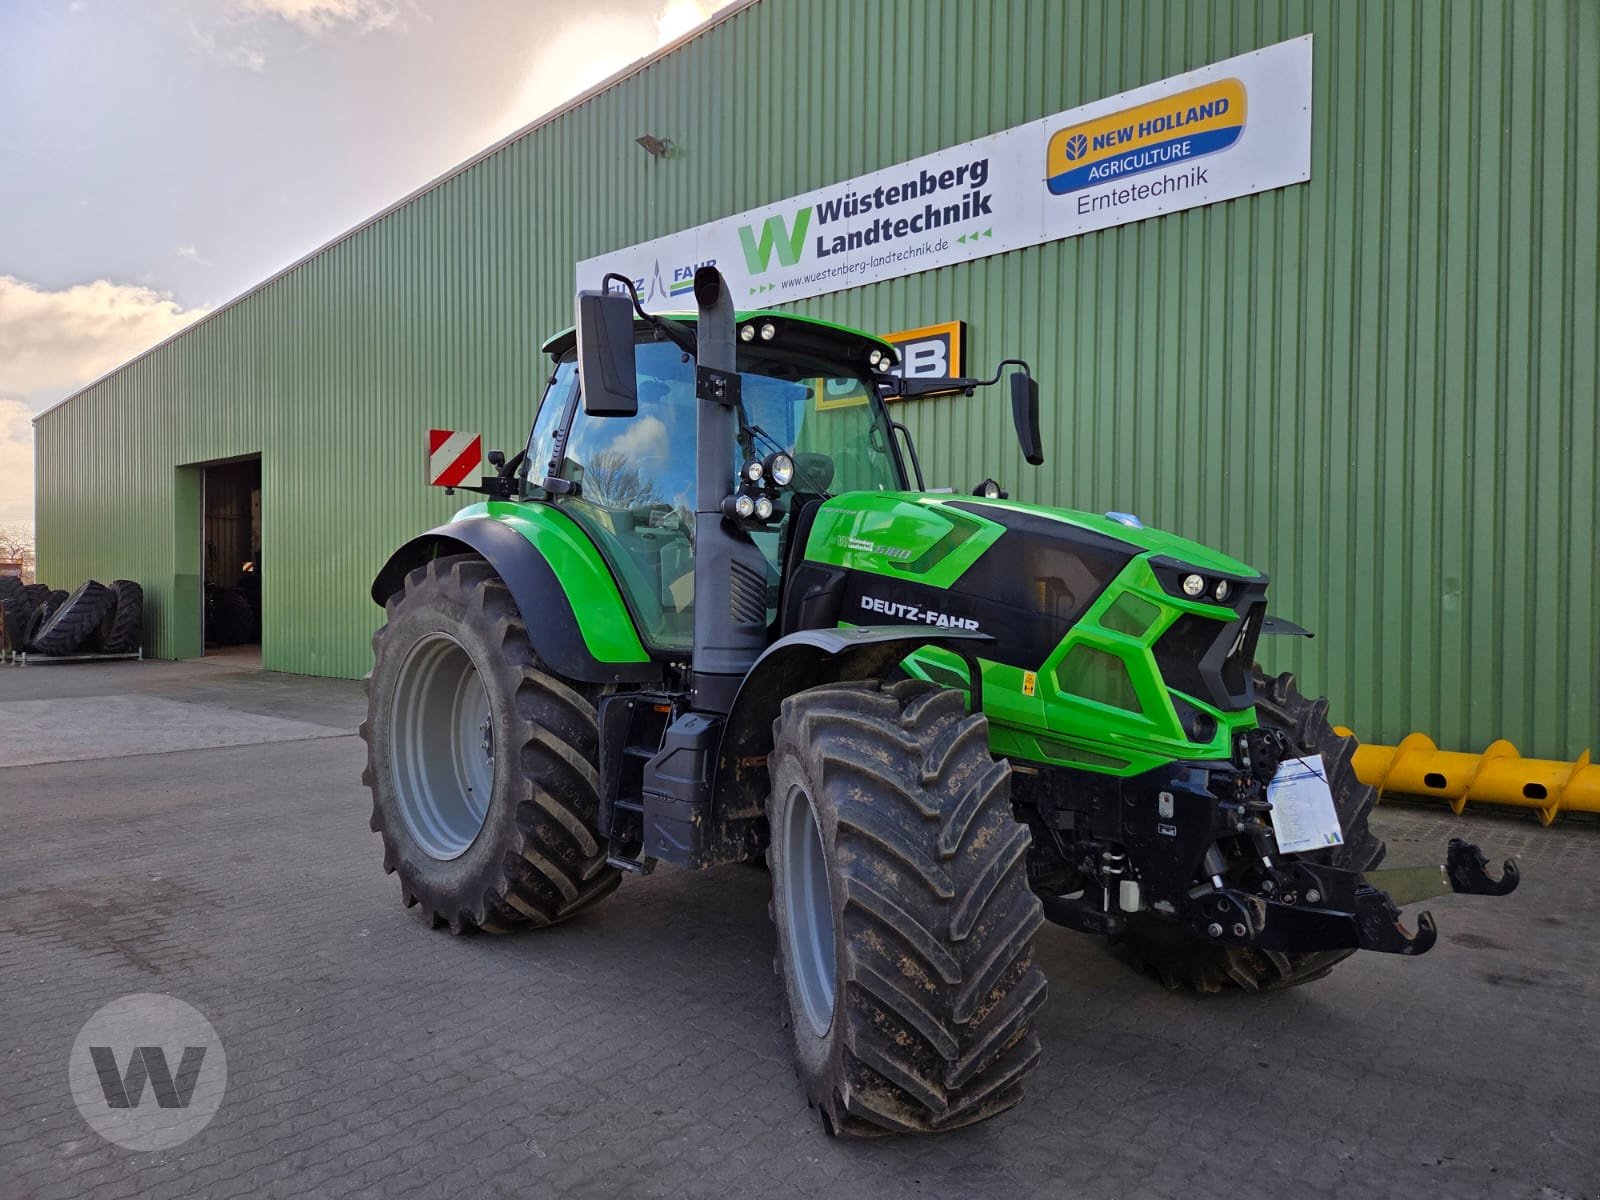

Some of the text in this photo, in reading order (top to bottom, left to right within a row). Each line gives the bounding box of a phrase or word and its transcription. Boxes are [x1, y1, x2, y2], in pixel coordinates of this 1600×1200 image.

[1092, 97, 1230, 151] NEW HOLLAND
[1087, 140, 1192, 182] AGRICULTURE
[816, 158, 989, 225] Wüstenberg
[1076, 166, 1209, 216] Erntetechnik
[737, 206, 813, 276] W
[816, 190, 993, 259] Landtechnik
[780, 238, 949, 290] www.wuestenberg-landtechnik.de
[860, 595, 980, 632] DEUTZ-FAHR
